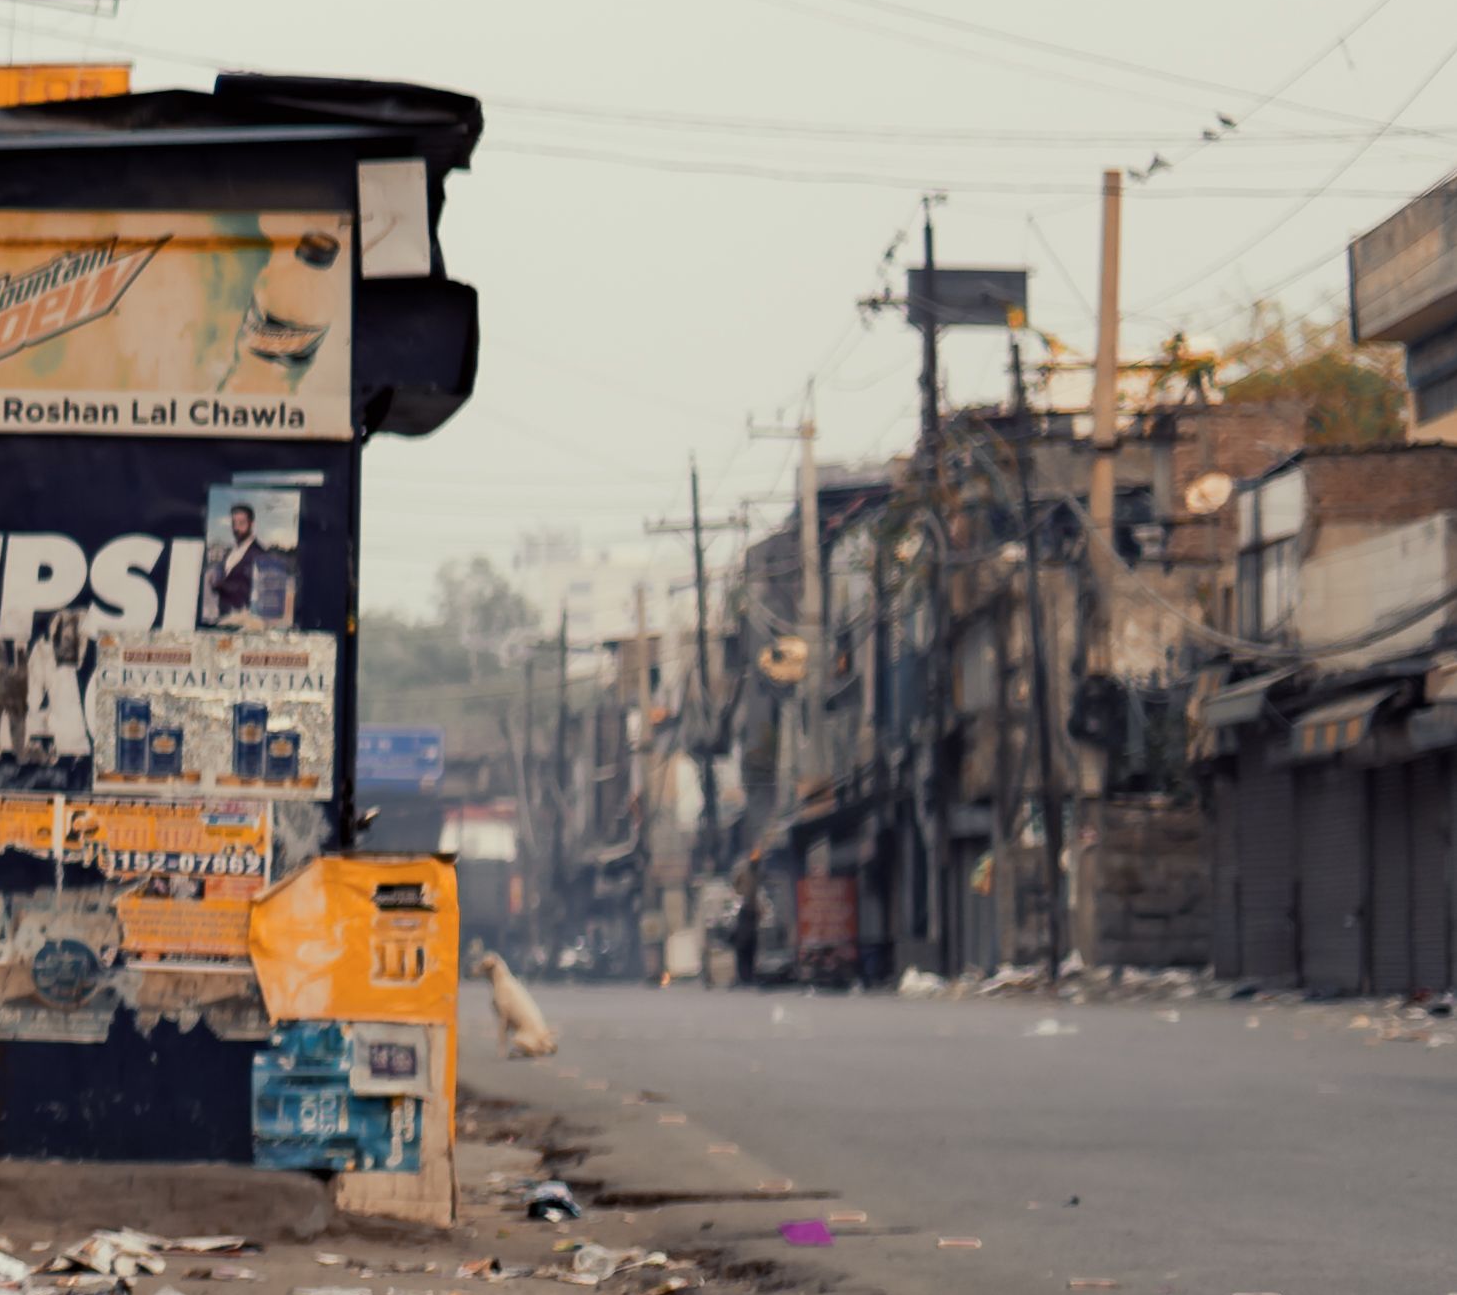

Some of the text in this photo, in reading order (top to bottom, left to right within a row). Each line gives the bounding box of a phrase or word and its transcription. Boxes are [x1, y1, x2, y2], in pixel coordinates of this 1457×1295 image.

[3, 396, 305, 429] Roshan Lal Chawla
[101, 668, 214, 688] CRYSTAL
[217, 671, 328, 691] CRYSTAL
